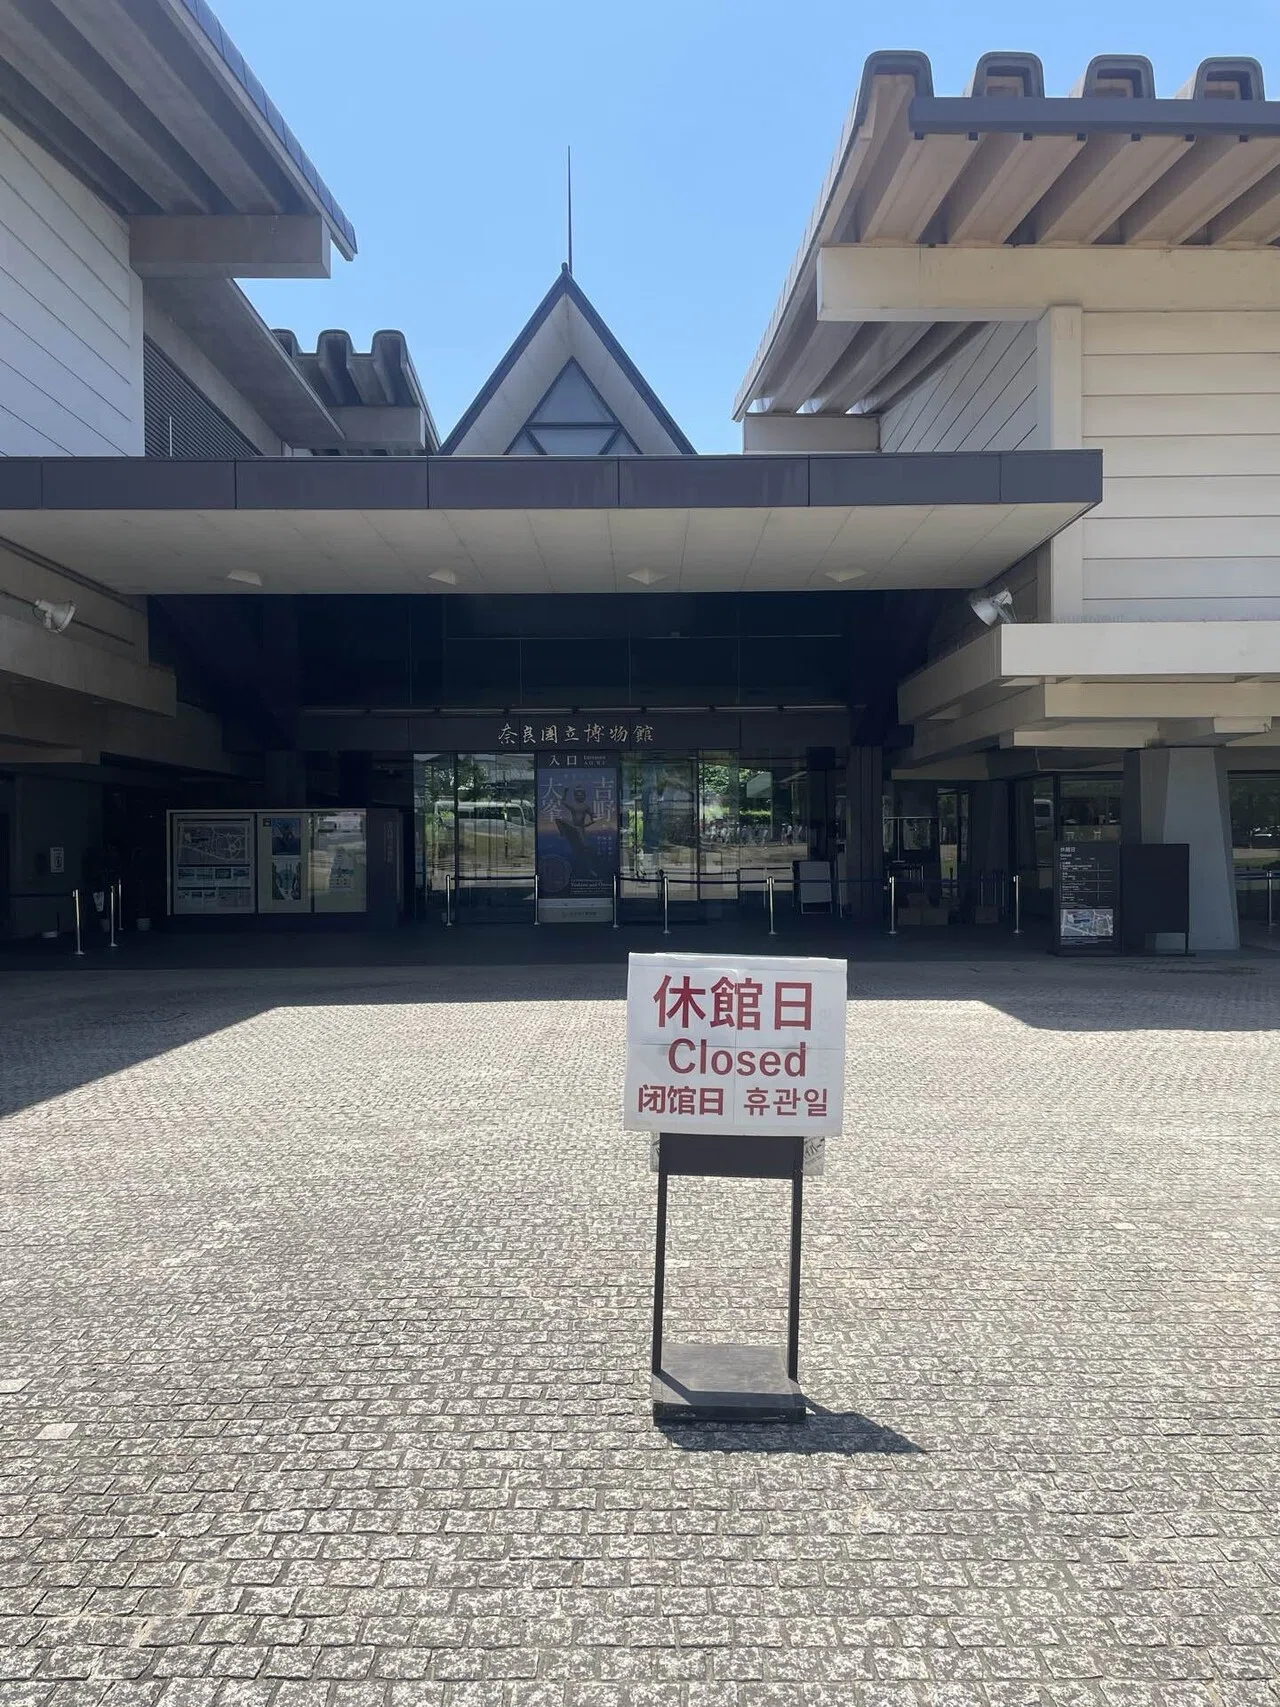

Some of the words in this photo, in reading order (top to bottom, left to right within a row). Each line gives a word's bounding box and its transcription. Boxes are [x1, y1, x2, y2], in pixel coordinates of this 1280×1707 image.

[549, 754, 577, 767] 入口
[653, 974, 813, 1031] 休館日
[668, 1038, 807, 1077] Closed
[638, 1084, 724, 1116] 闭馆日
[743, 1087, 828, 1117] 휴관일
